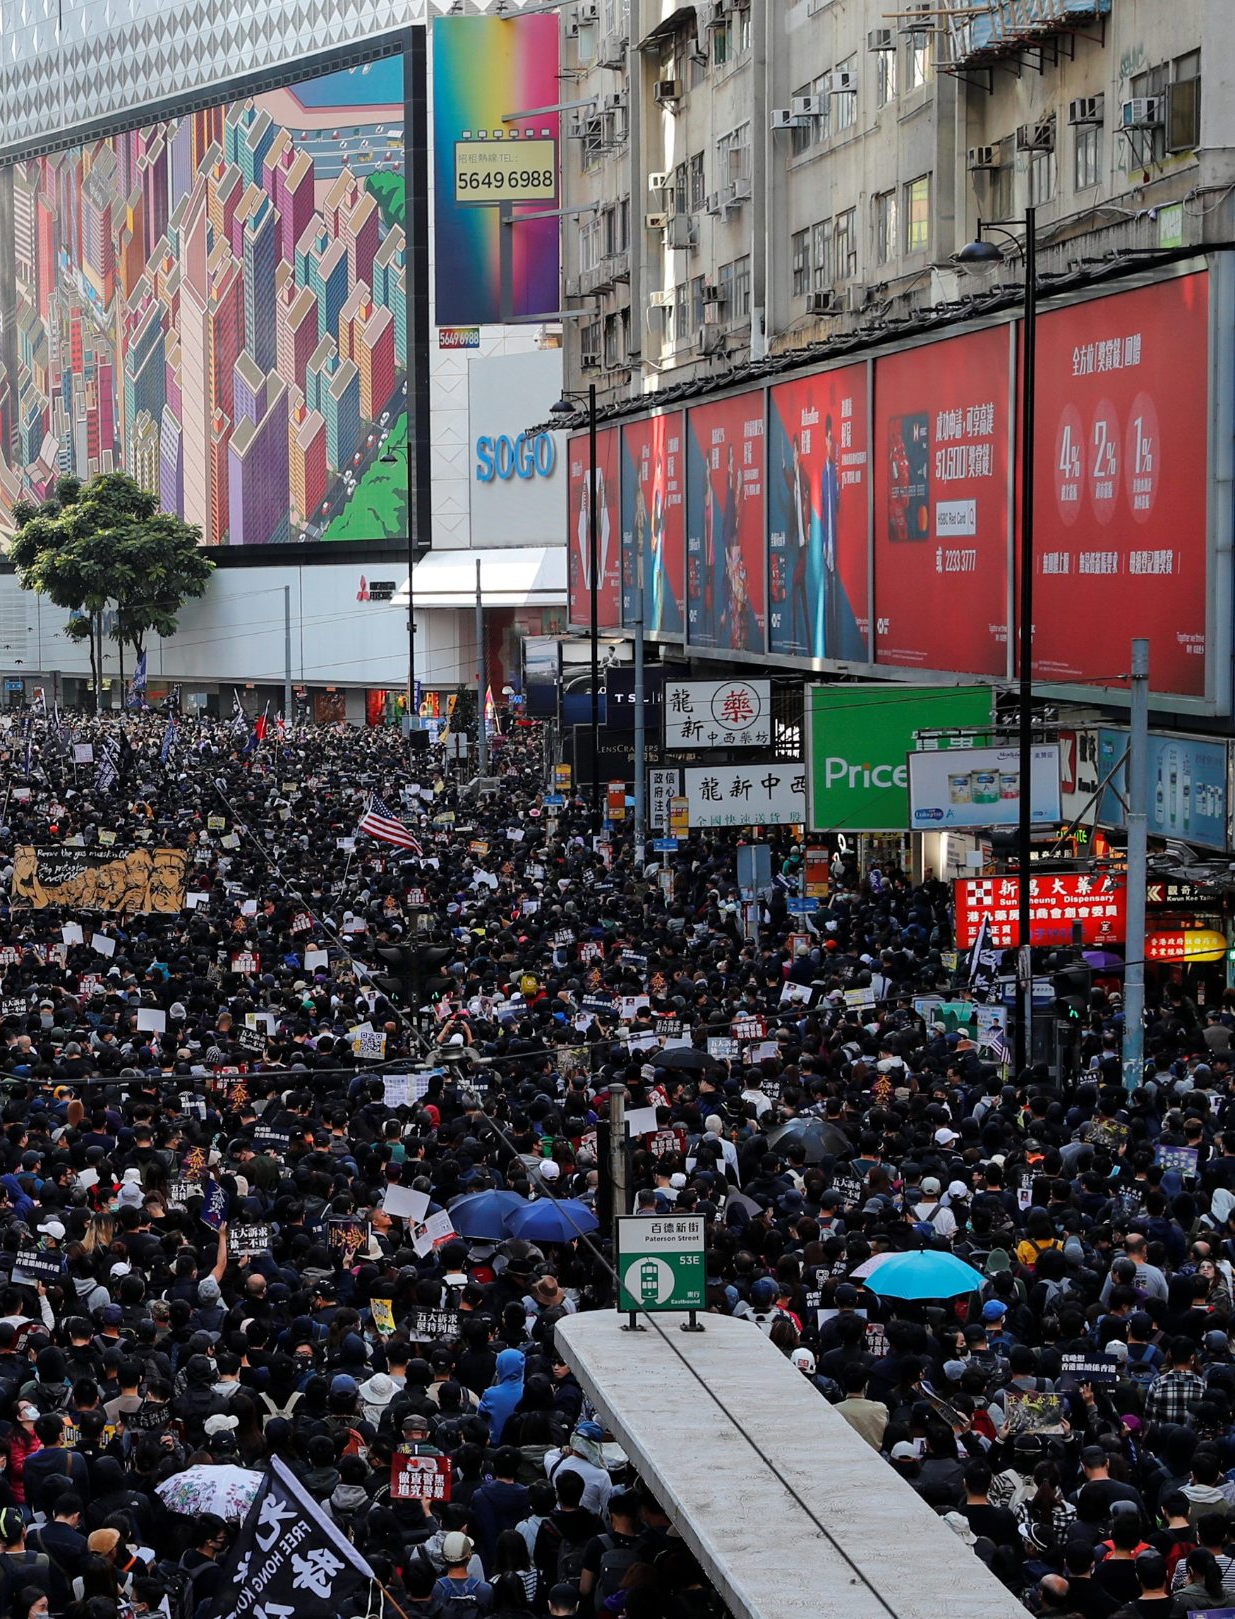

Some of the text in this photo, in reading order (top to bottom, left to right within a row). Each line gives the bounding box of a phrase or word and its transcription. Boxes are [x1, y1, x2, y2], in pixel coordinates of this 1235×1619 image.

[459, 170, 553, 189] 5649 6988
[440, 332, 479, 345] 5649 6988
[1094, 421, 1115, 478] 2%
[1134, 416, 1152, 474] 1%
[476, 432, 554, 483] SOGO
[1060, 425, 1080, 479] 4%
[949, 512, 957, 525] Red
[957, 511, 966, 524] Card
[946, 550, 961, 572] 2233
[961, 549, 976, 571] 3777
[721, 690, 753, 723] 藥
[707, 731, 769, 749] 中西藥坊
[61, 848, 72, 857] the
[73, 850, 86, 860] gas
[64, 872, 78, 880] OK
[1030, 897, 1056, 905] heung
[1064, 895, 1114, 903] Dispensary
[968, 925, 1011, 935] 正正貨
[230, 1228, 268, 1239] 五大訴求
[651, 1222, 698, 1233] 百德新街
[230, 1238, 268, 1249] 缺一不可
[680, 1256, 700, 1264] 53E
[417, 1311, 458, 1323] 五大訴求
[417, 1322, 458, 1335] 堅持到底
[1062, 1354, 1085, 1362] 我哋想
[1062, 1363, 1116, 1373] 香港繼續係香港
[398, 1472, 445, 1485] 徹查警黑
[398, 1484, 445, 1498] 追究警暴
